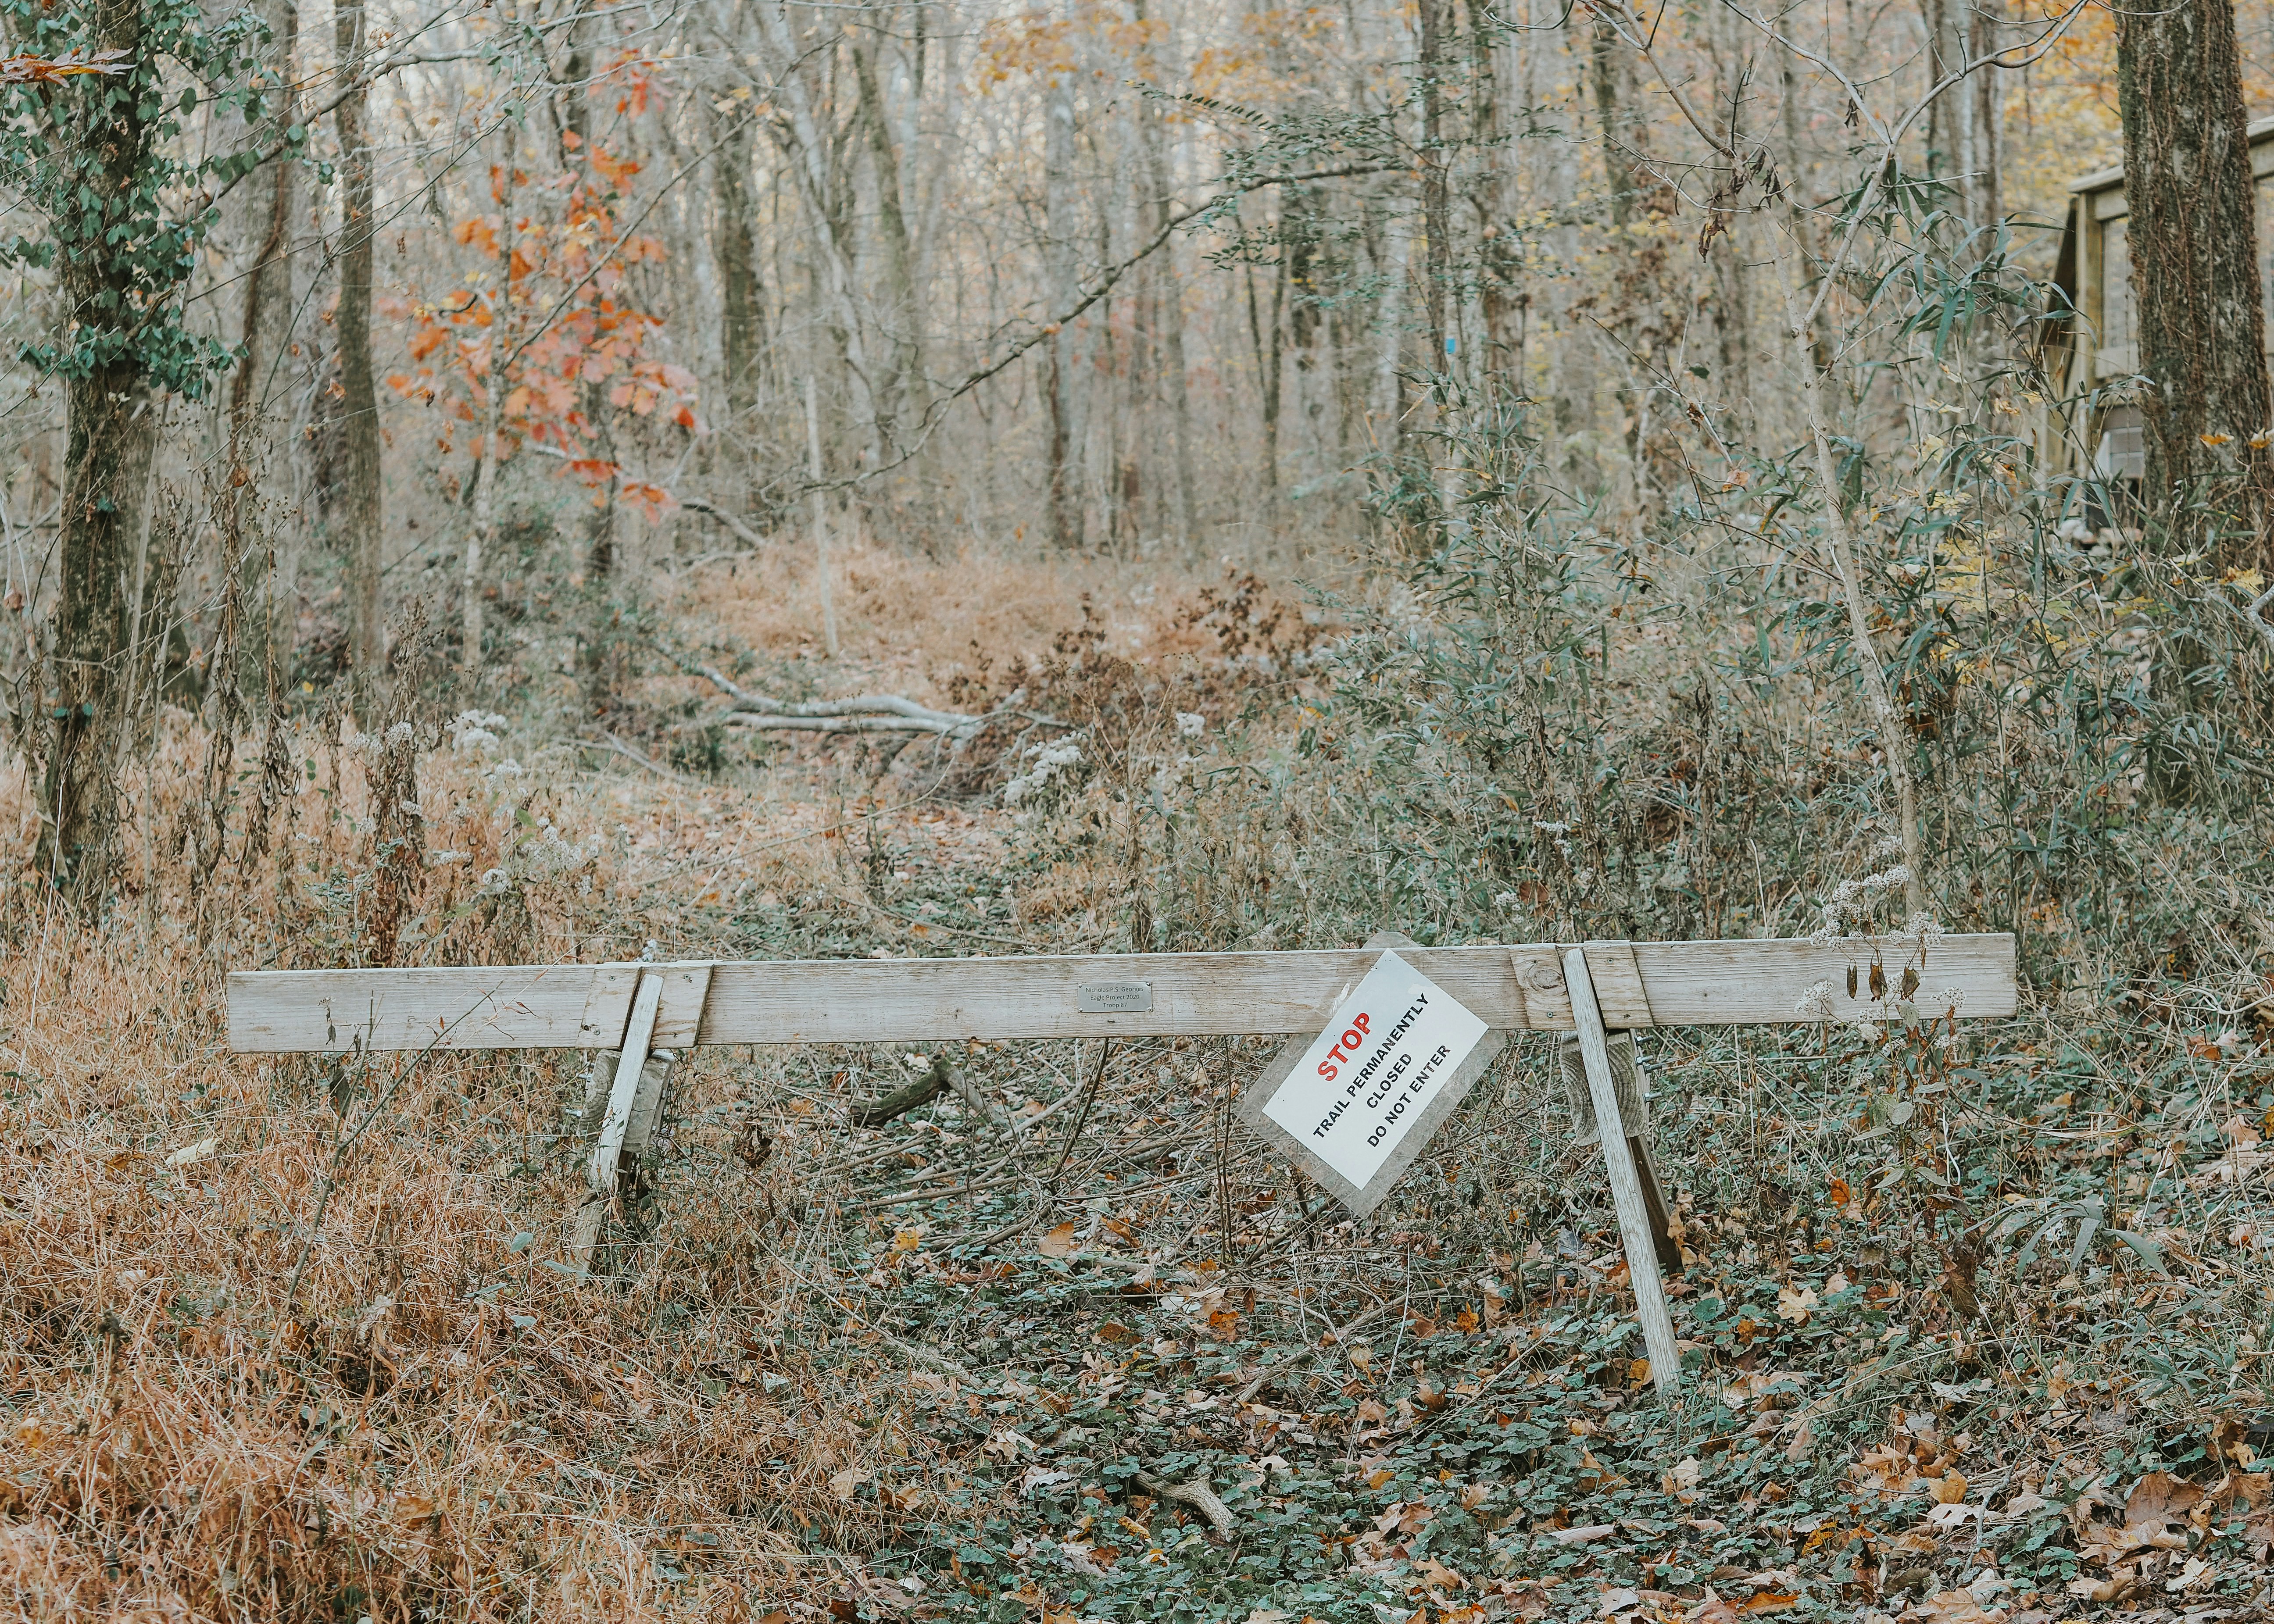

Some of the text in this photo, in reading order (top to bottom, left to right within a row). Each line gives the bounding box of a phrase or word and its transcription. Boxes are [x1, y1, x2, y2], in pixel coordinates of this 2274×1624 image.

[1313, 992, 1429, 1138] TRAIL PERMANENTLY
[1317, 1012, 1371, 1081] STOP
[1367, 1053, 1412, 1109] CLOSED
[1367, 1045, 1451, 1147] DO NOT ENTER
